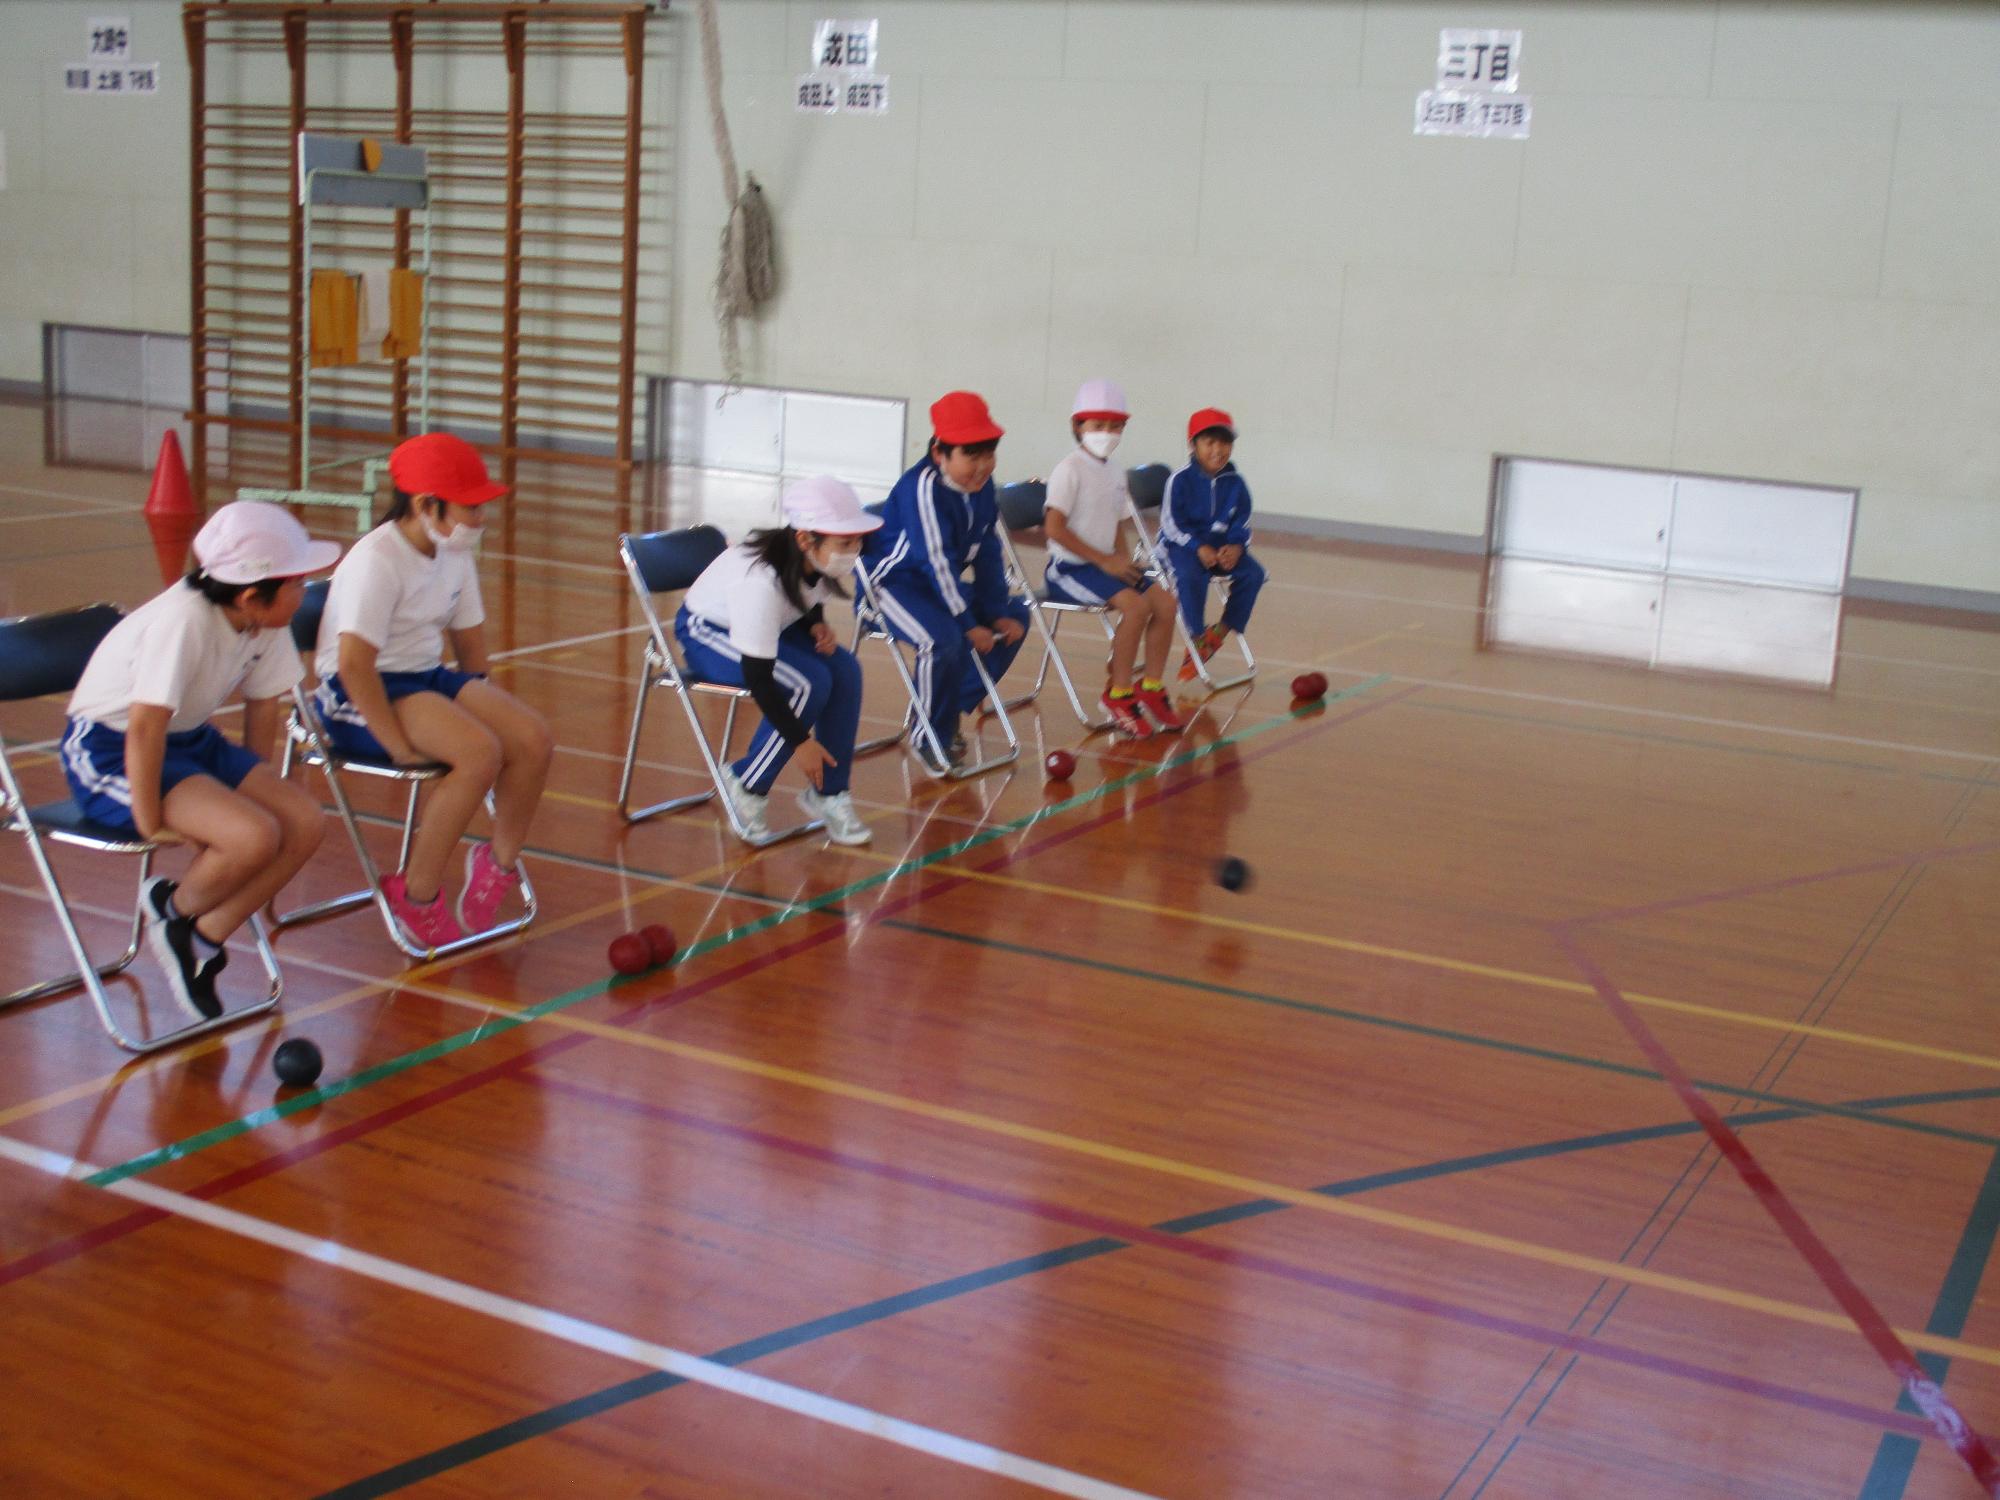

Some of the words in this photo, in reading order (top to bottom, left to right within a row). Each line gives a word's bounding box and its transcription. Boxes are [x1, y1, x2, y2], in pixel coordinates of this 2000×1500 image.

[821, 31, 868, 65] 成田
[1445, 43, 1510, 81] 三丁目
